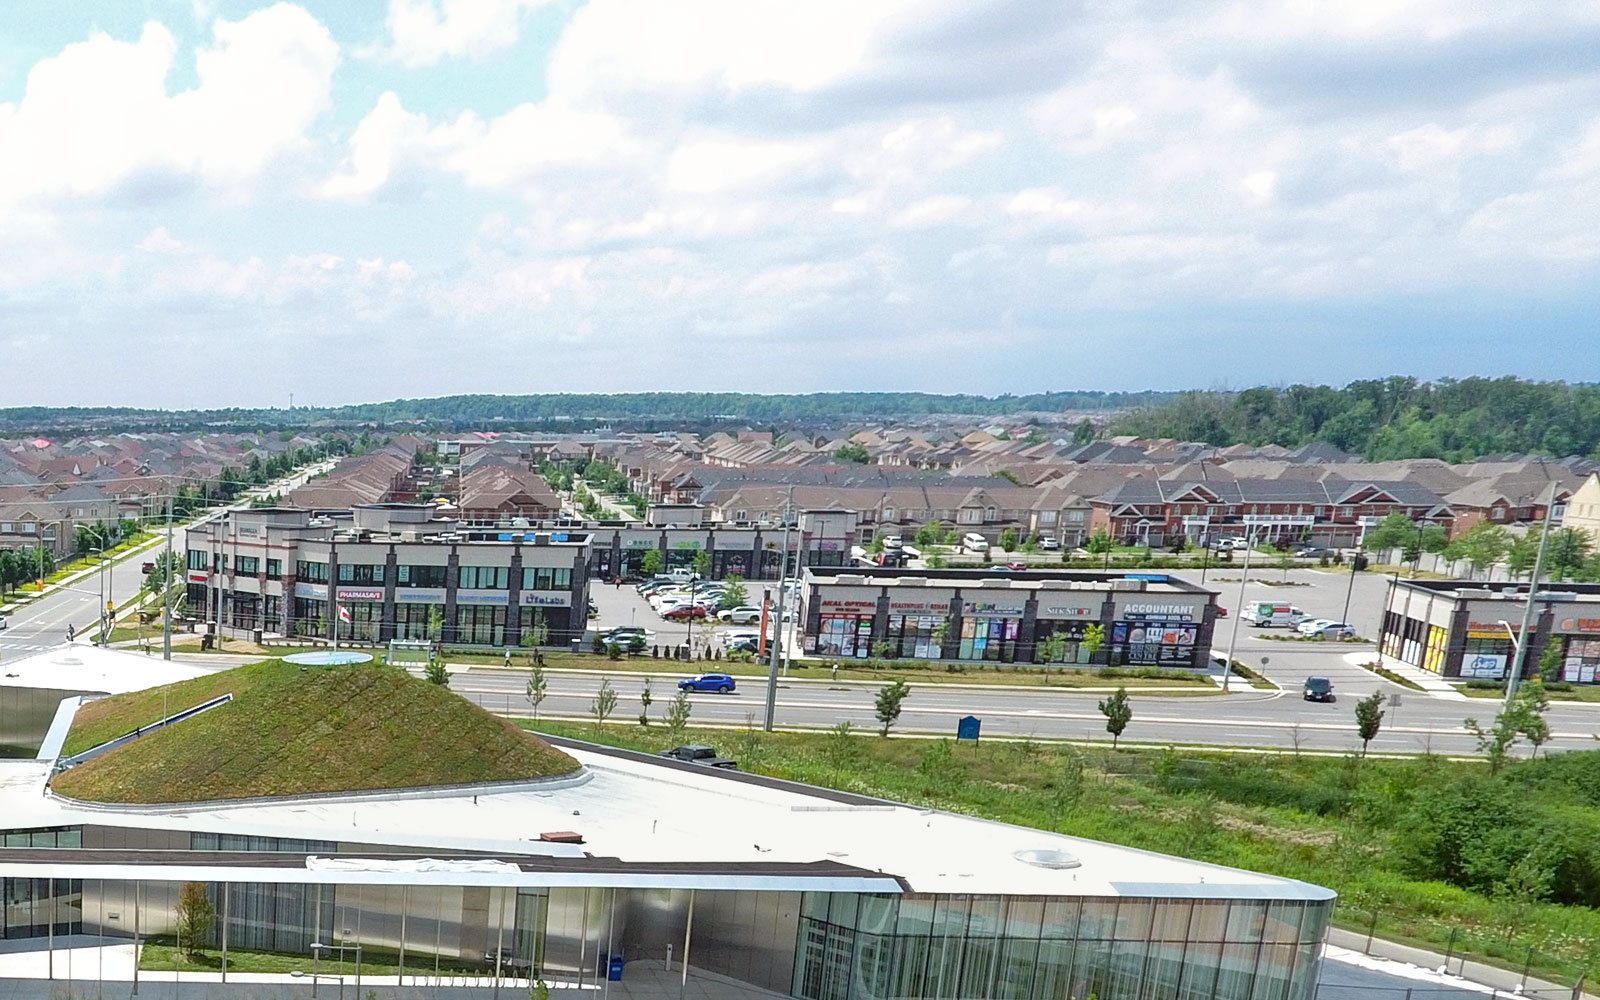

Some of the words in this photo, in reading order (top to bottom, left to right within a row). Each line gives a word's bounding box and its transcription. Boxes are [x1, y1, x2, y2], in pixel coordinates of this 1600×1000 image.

[339, 591, 380, 599] PHARMASAVE
[526, 594, 565, 604] LifeLabs
[1124, 604, 1194, 614] ACCOUNTANT
